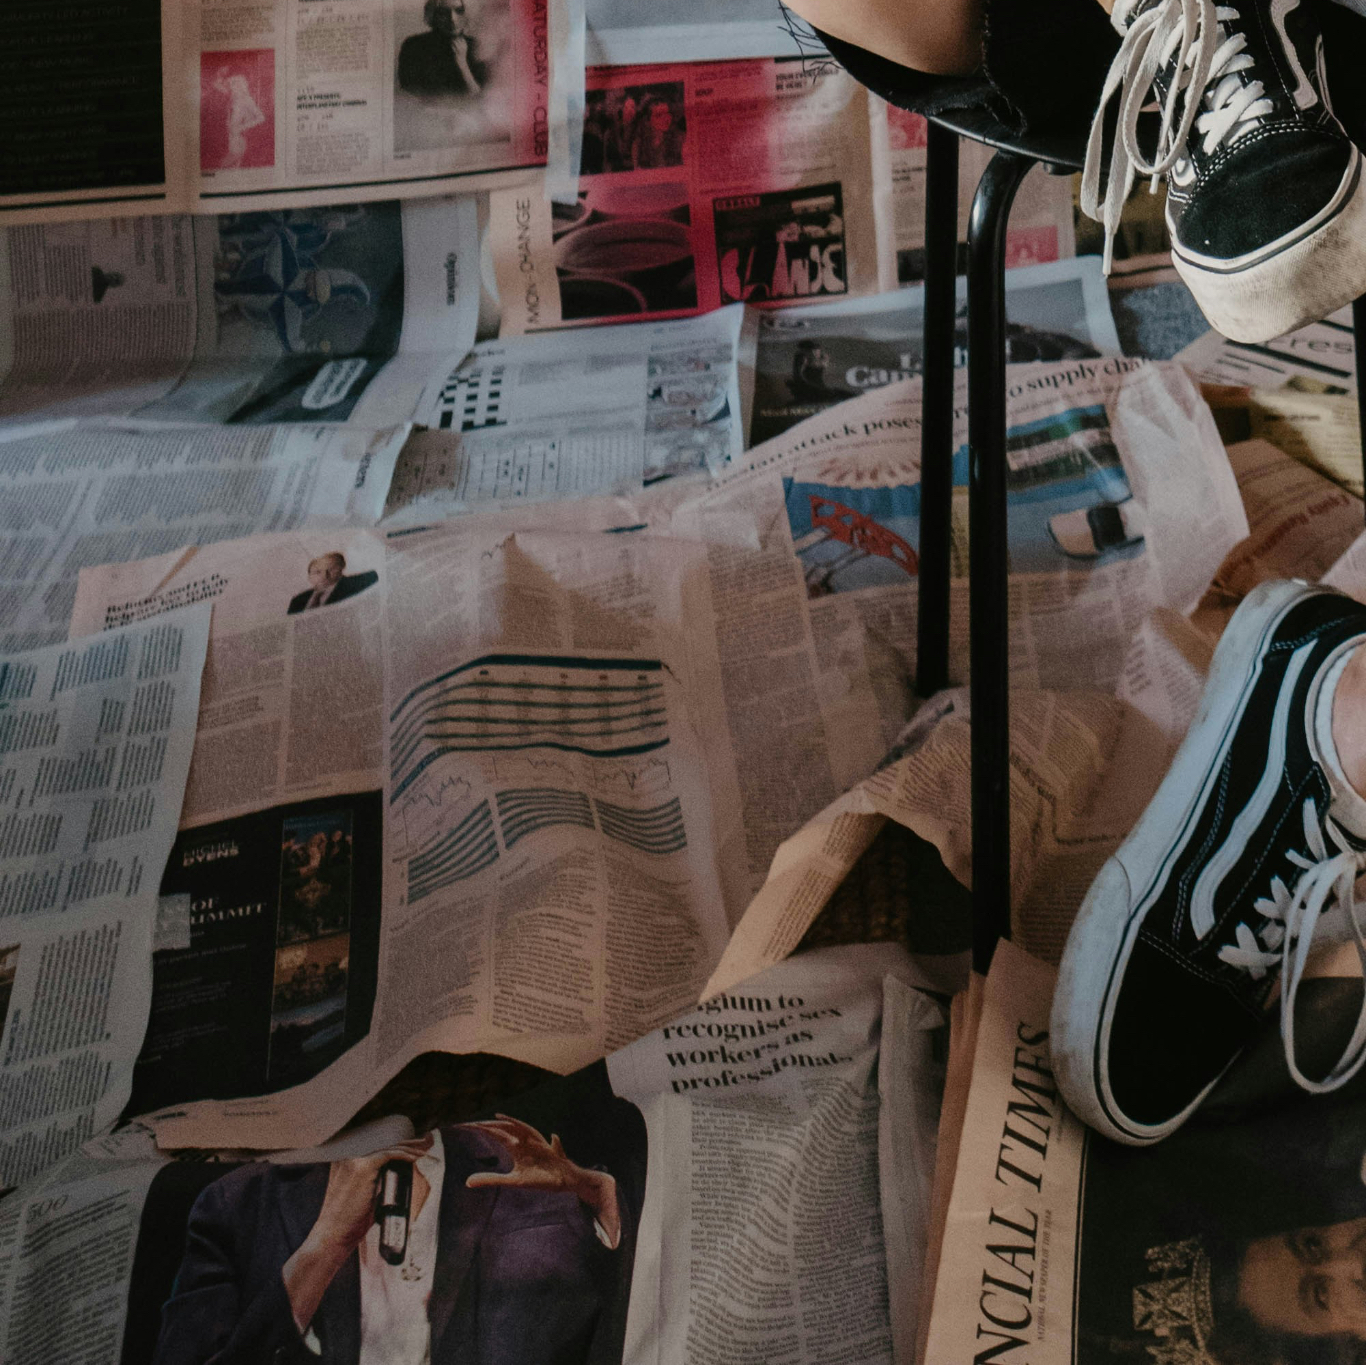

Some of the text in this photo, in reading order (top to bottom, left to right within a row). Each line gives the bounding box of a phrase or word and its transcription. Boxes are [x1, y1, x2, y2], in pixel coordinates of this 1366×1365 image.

[532, 104, 549, 157] CLUB
[515, 197, 531, 275] CHANGE
[1024, 362, 1099, 396] supply
[777, 993, 805, 1010] to
[662, 1006, 843, 1044] recognise sex
[665, 1029, 815, 1068] workers as
[670, 1051, 854, 1095] professionals
[994, 1021, 1057, 1194] TIMES
[973, 1207, 1038, 1365] NCIAL
